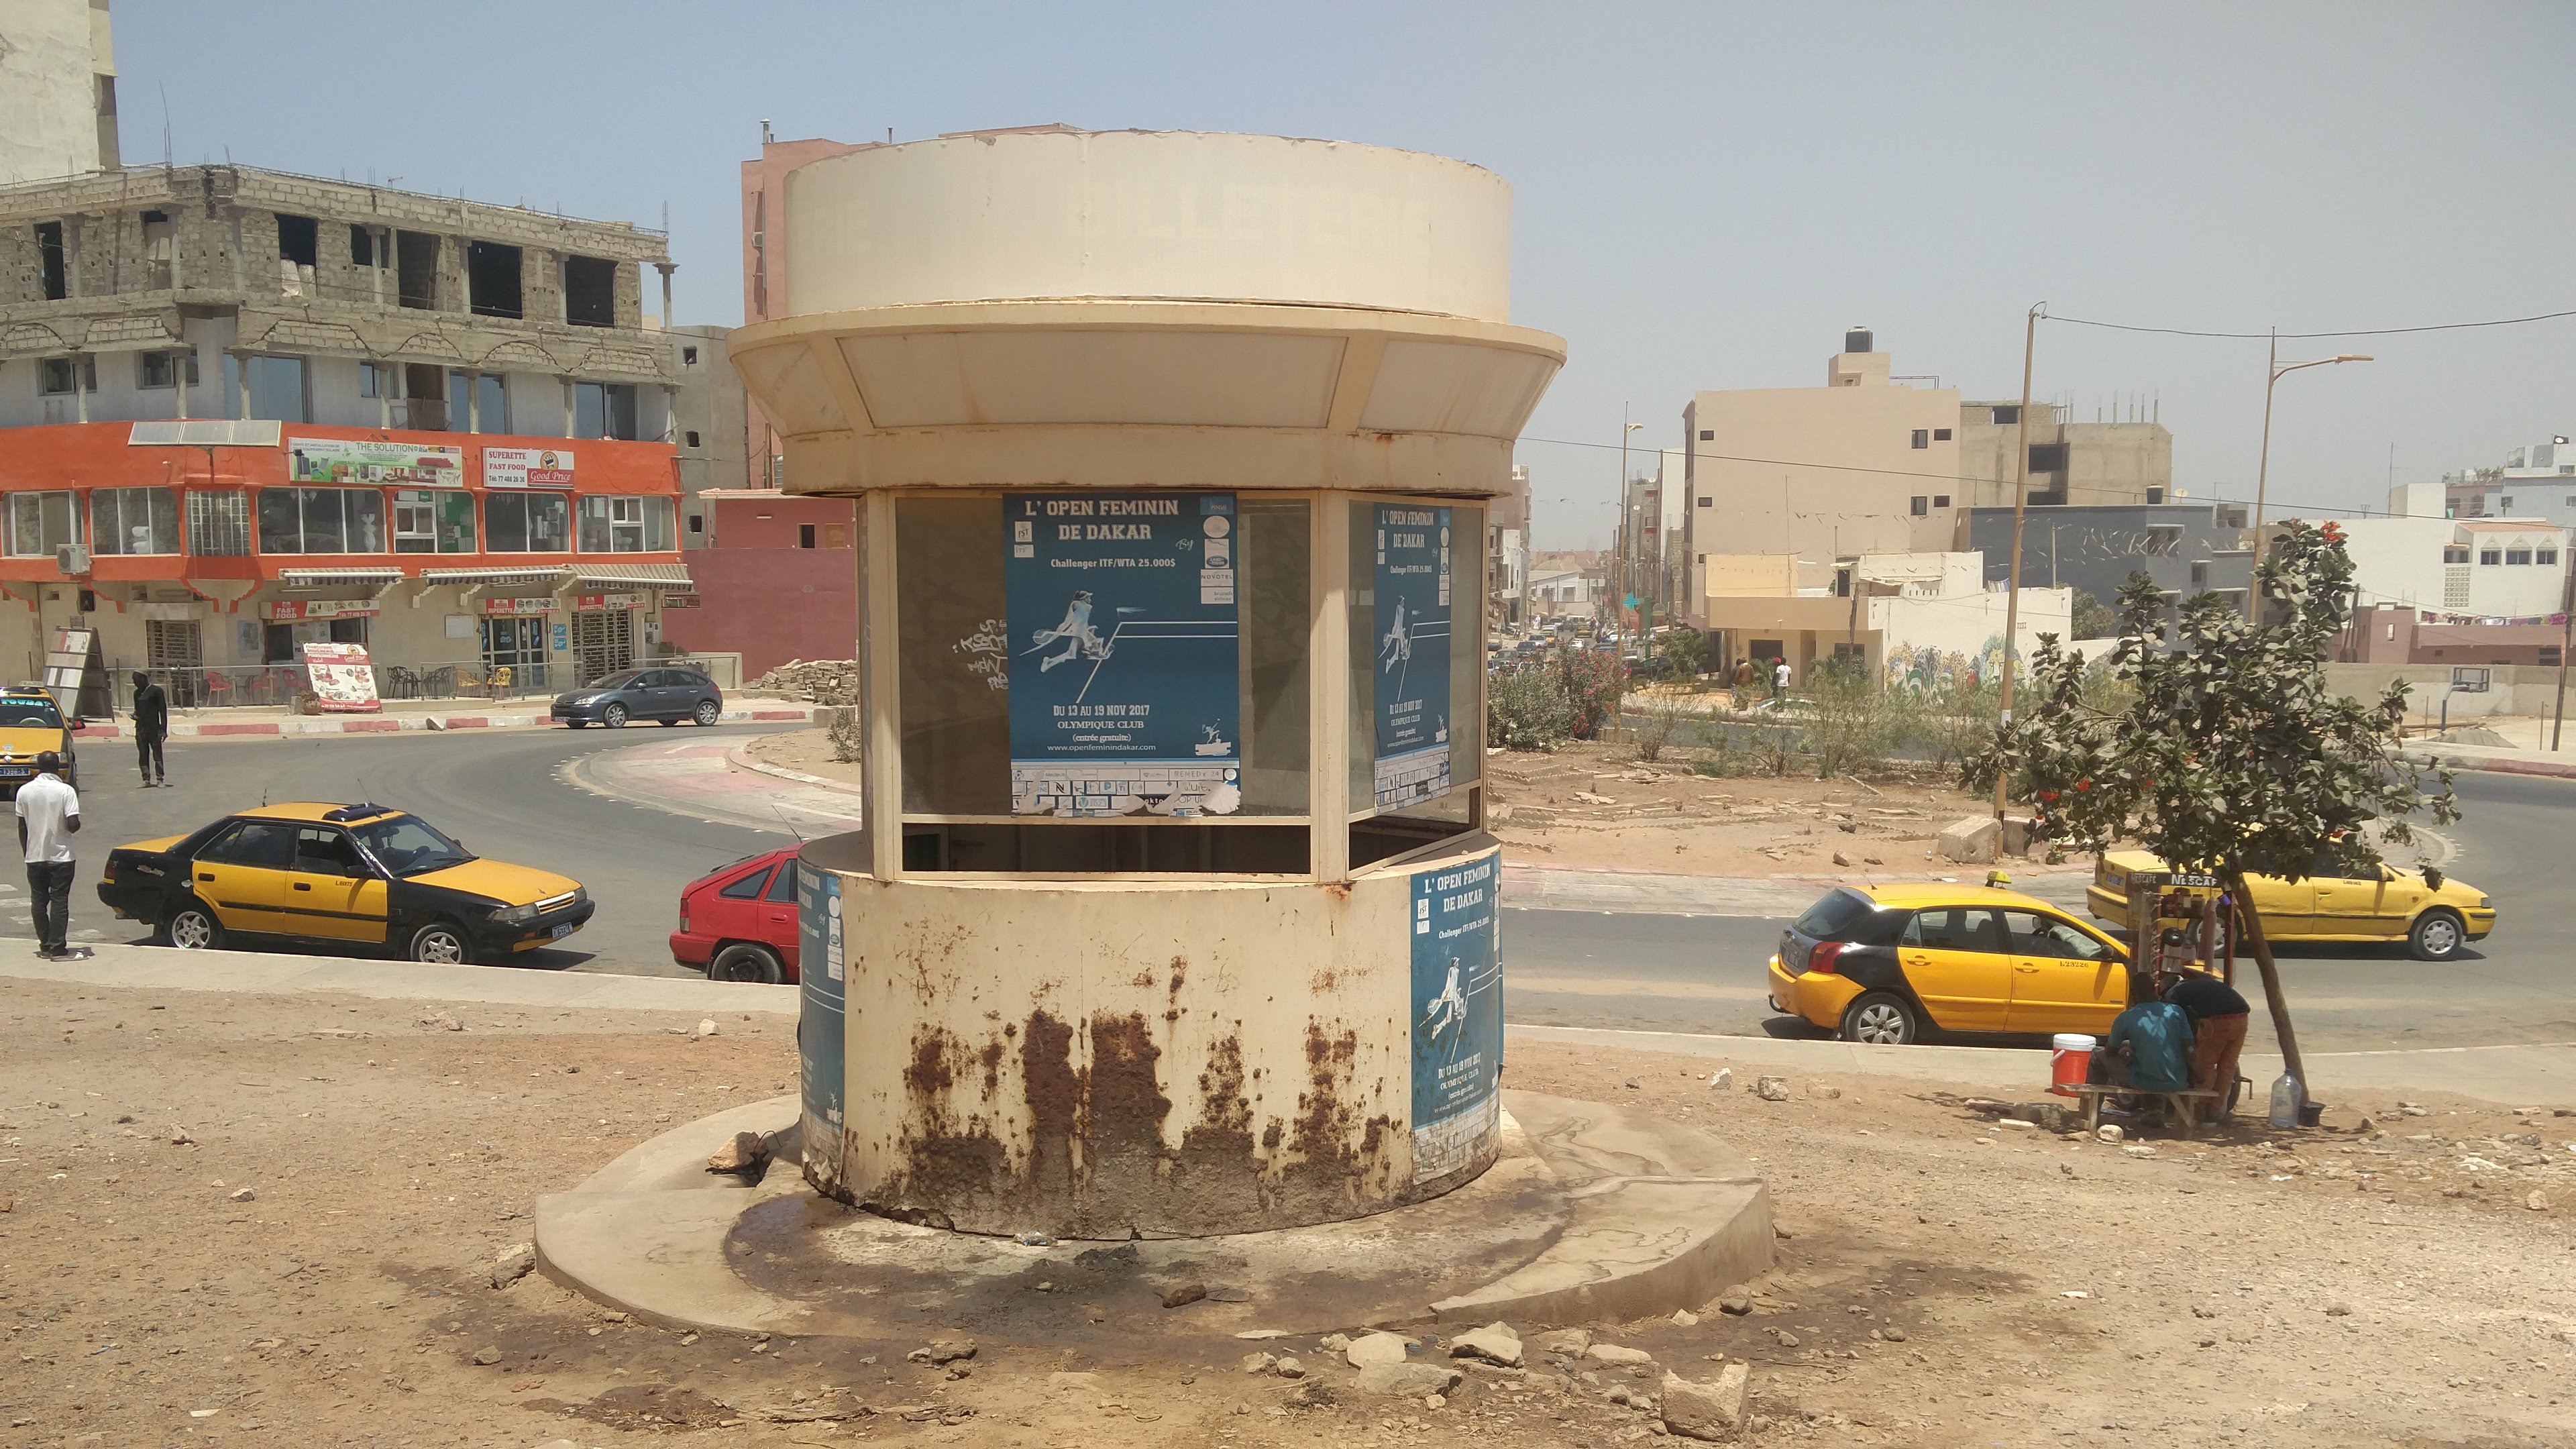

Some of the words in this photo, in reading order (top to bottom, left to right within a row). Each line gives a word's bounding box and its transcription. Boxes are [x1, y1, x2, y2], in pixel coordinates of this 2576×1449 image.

[356, 443, 372, 451] THE
[374, 443, 414, 453] SOLUTION
[488, 451, 527, 460] SUPERETTE
[531, 470, 551, 481] Good
[1046, 500, 1094, 516] OPEN
[1099, 500, 1179, 516] FEMININ
[1059, 525, 1082, 540] DE
[1086, 525, 1152, 540] DAKAR
[1393, 533, 1401, 547] DE
[1403, 533, 1425, 547] DAKAR
[1051, 558, 1097, 569] Challenger
[1099, 559, 1136, 568] ITF/WTA
[1053, 705, 1065, 716] DU
[1068, 705, 1077, 716] 13
[1080, 706, 1091, 716] AU
[1094, 705, 1104, 716] 19
[1107, 704, 1126, 716] NOV
[1129, 704, 1150, 716] 2017
[1057, 721, 1115, 729] OLYMPIQUE
[1047, 744, 1156, 752] www.openfeminindakar.com
[1437, 873, 1462, 891] OPEN
[1464, 863, 1490, 885] FEMININ
[1444, 896, 1456, 912] DE
[1457, 888, 1483, 910] DAKAR
[1439, 927, 1462, 939] Challenger
